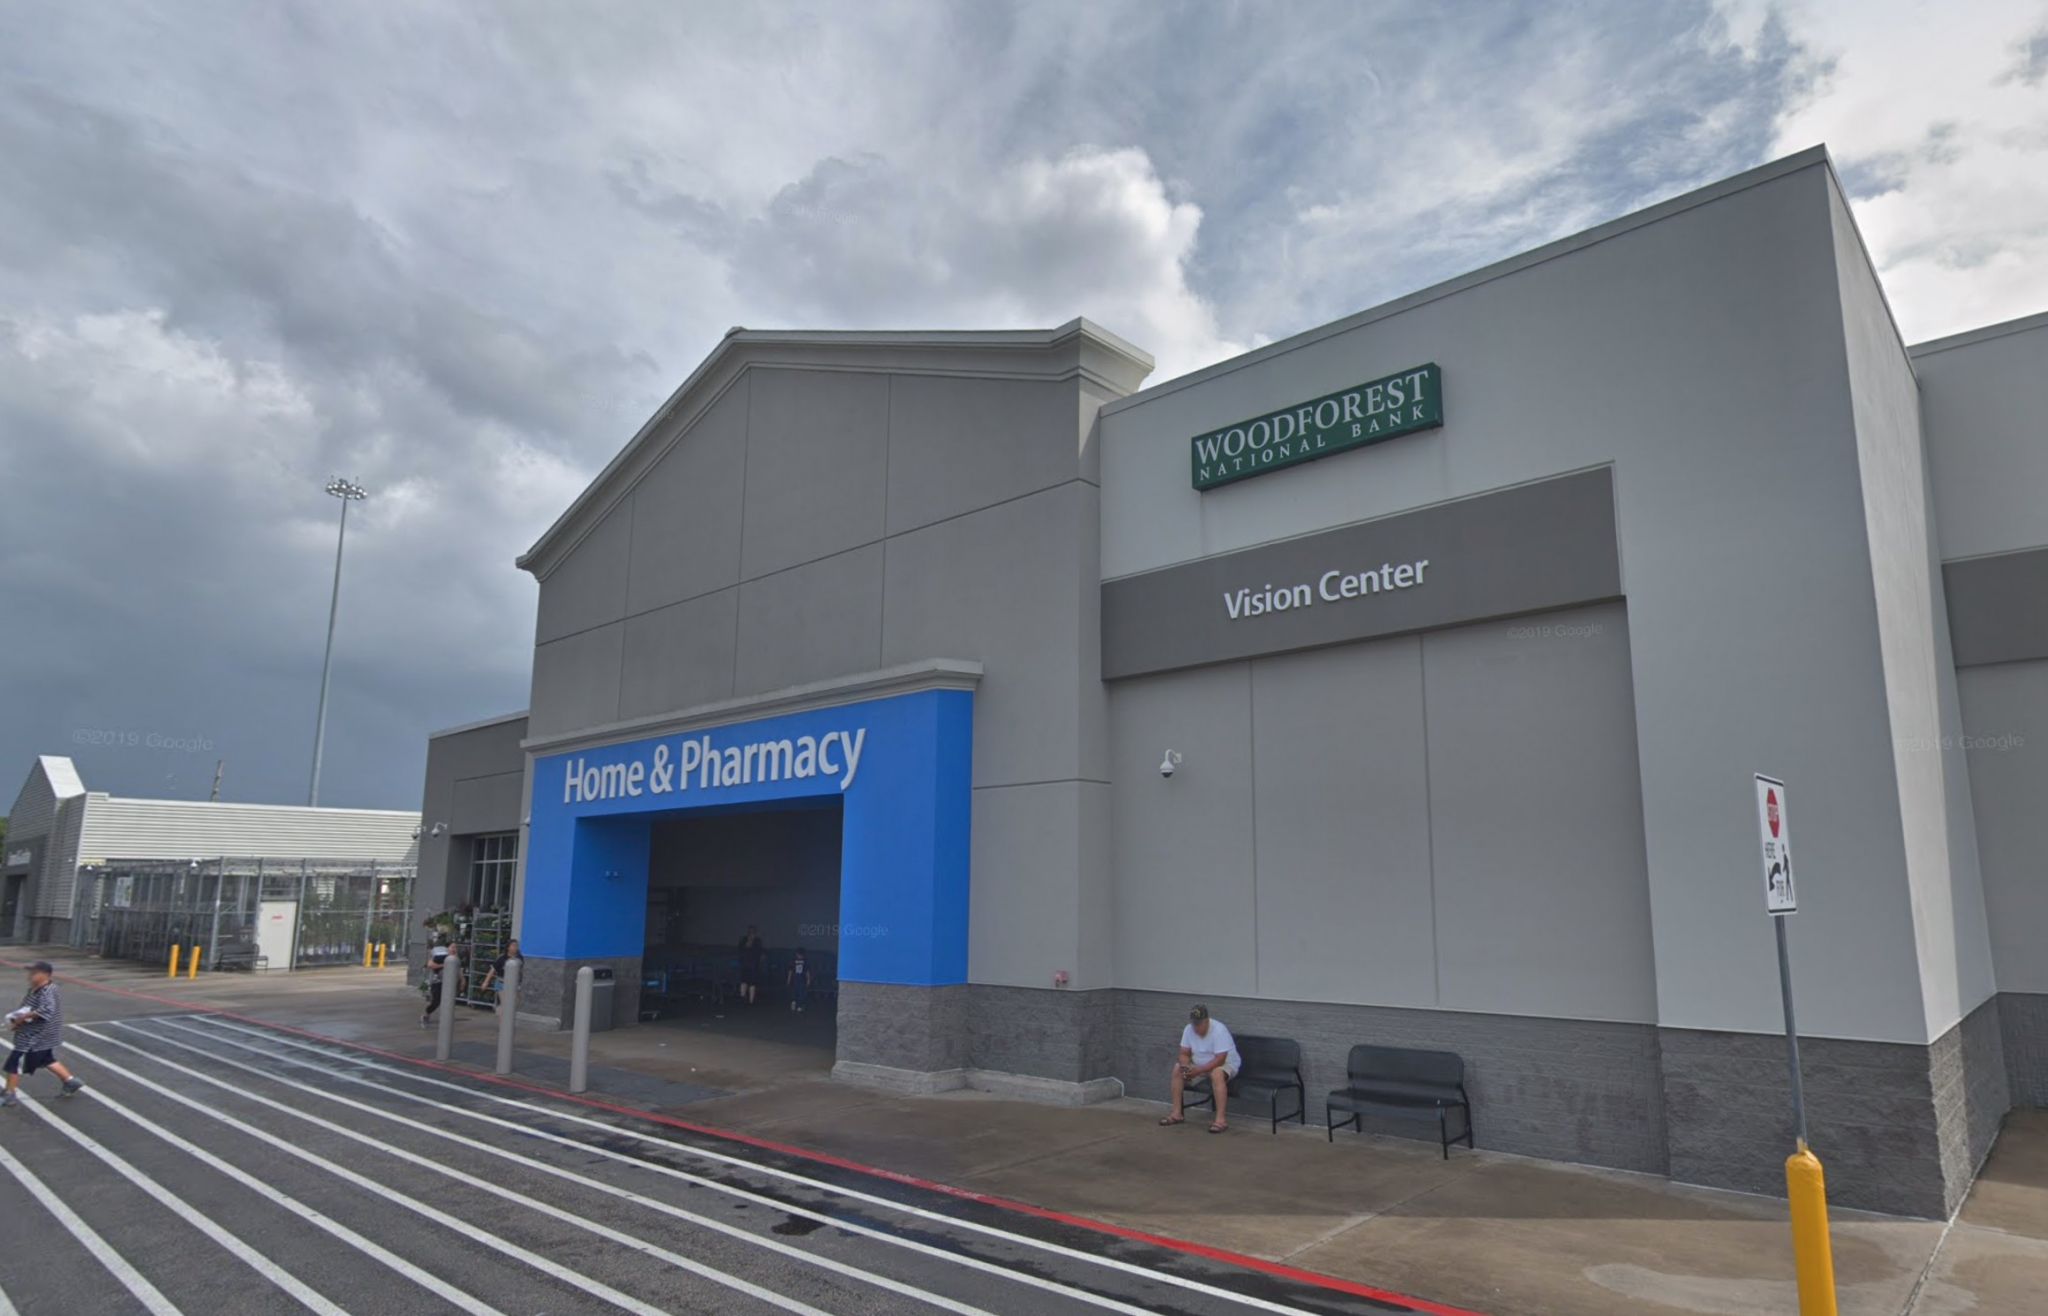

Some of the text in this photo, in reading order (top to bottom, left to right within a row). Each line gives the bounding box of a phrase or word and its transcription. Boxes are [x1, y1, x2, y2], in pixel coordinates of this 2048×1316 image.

[1196, 369, 1429, 465] WOODFOREST
[1199, 404, 1424, 481] NATIONAL BANK
[1224, 559, 1429, 619] Vision Center
[563, 728, 867, 803] Home & Pharmacy
